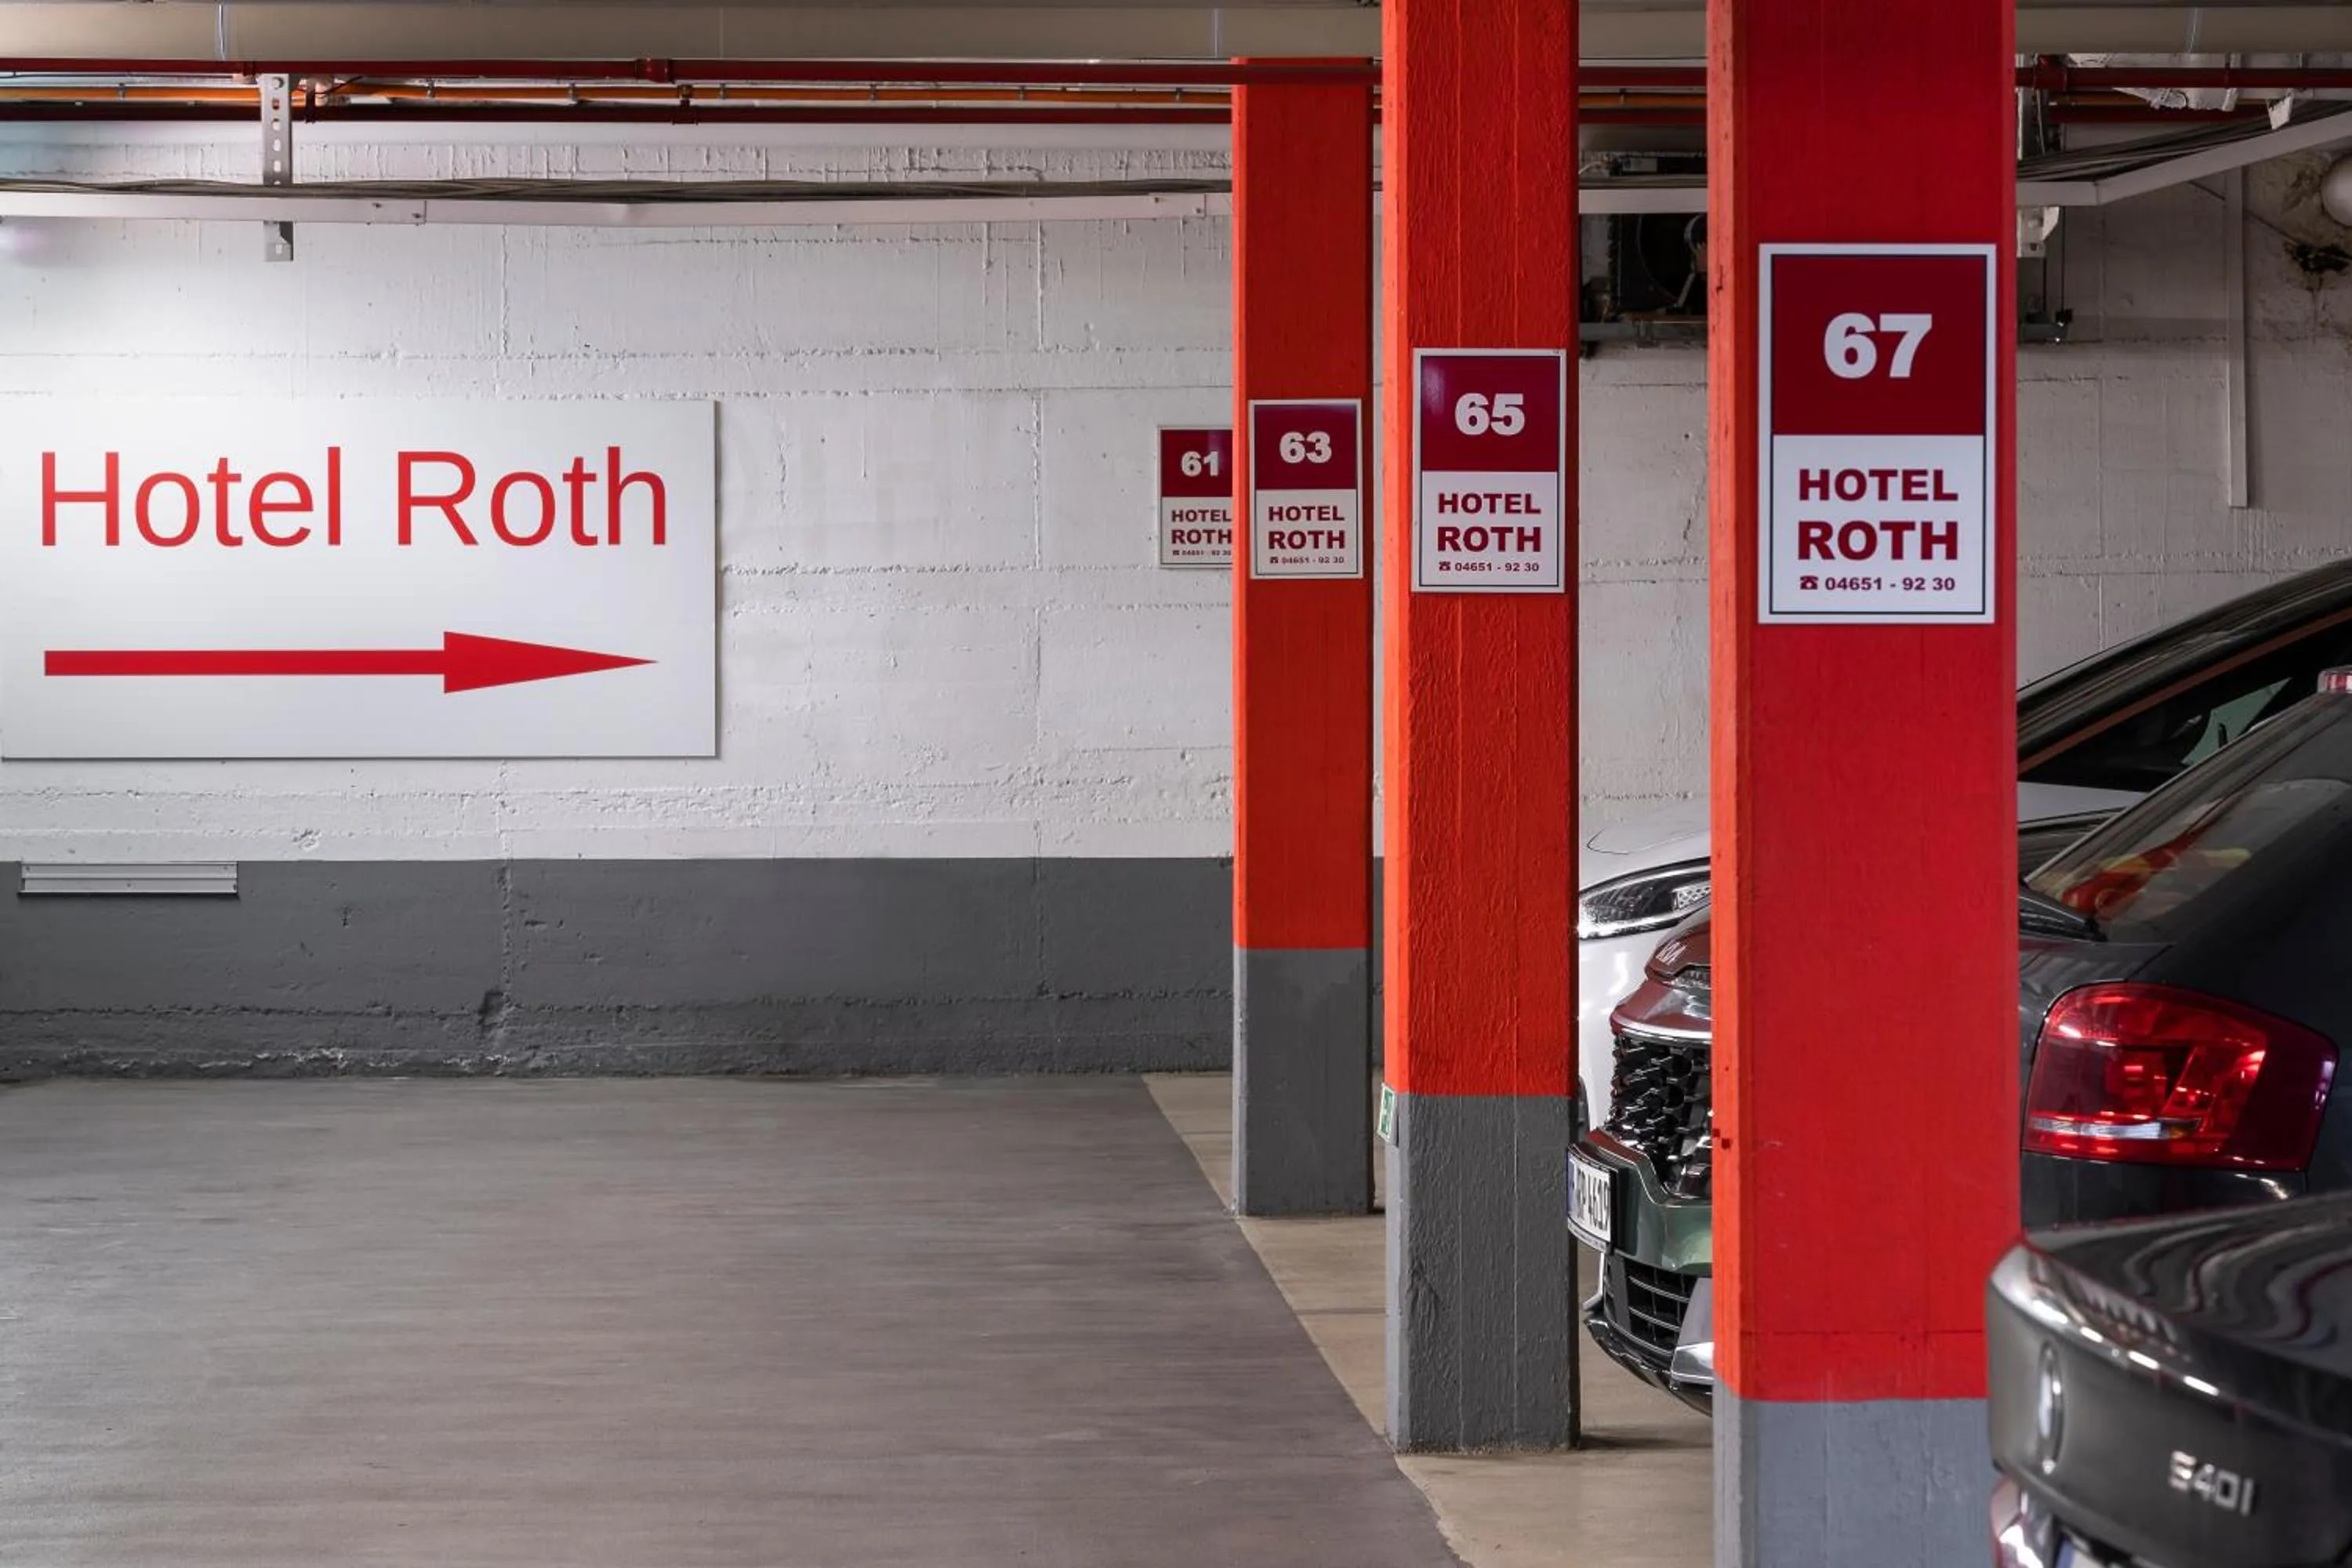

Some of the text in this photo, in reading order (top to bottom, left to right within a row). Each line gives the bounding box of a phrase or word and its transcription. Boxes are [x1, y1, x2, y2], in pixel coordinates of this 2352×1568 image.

[1824, 312, 1933, 379] 67
[1454, 392, 1526, 436] 65
[1279, 431, 1332, 463] 63
[1181, 451, 1219, 477] 61
[42, 446, 666, 547] Hotel Roth
[1798, 468, 1958, 502] HOTEL
[1268, 506, 1345, 521] HOTEL
[1438, 492, 1541, 515] HOTEL
[1171, 509, 1232, 523] HOTEL
[1171, 528, 1232, 545] ROTH
[1268, 529, 1345, 550] ROTH
[1437, 525, 1541, 553] ROTH
[1798, 520, 1958, 561] ROTH
[1332, 555, 1345, 564] 30
[1454, 561, 1493, 572] 04651
[1504, 561, 1521, 572] 92
[1524, 561, 1541, 572] 30
[1824, 576, 1883, 591] 04651
[1902, 576, 1926, 591] 92
[1933, 576, 1956, 591] 30
